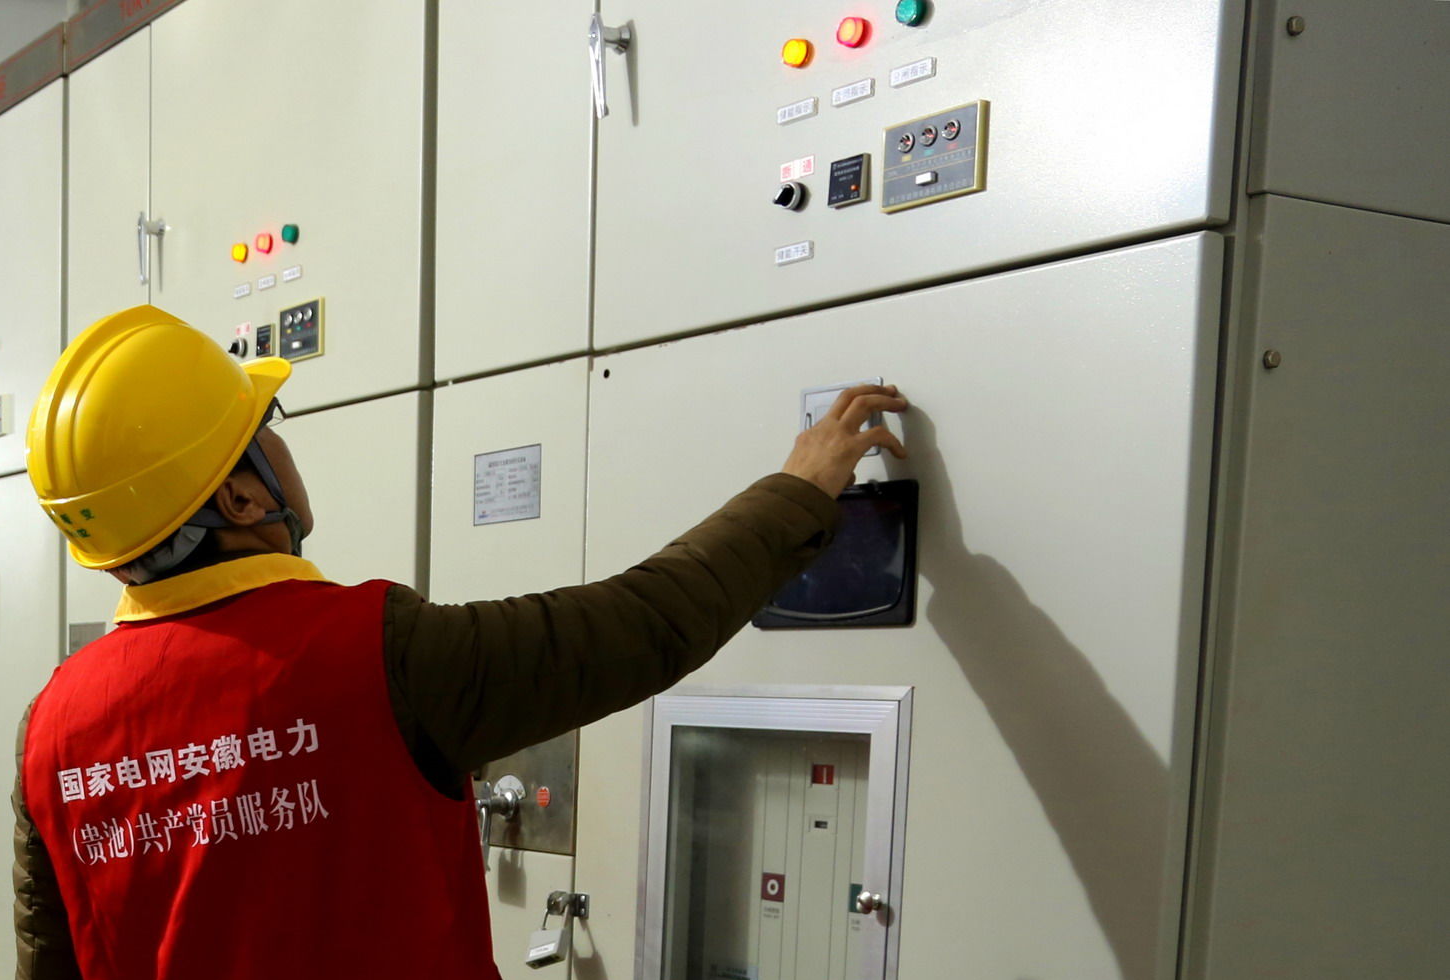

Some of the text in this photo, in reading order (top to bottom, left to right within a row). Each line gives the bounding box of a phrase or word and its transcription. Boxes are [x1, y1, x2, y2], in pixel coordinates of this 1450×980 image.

[56, 718, 320, 804] 国家电网安徽电力
[72, 778, 330, 867] (贵池)共产党员服务队
